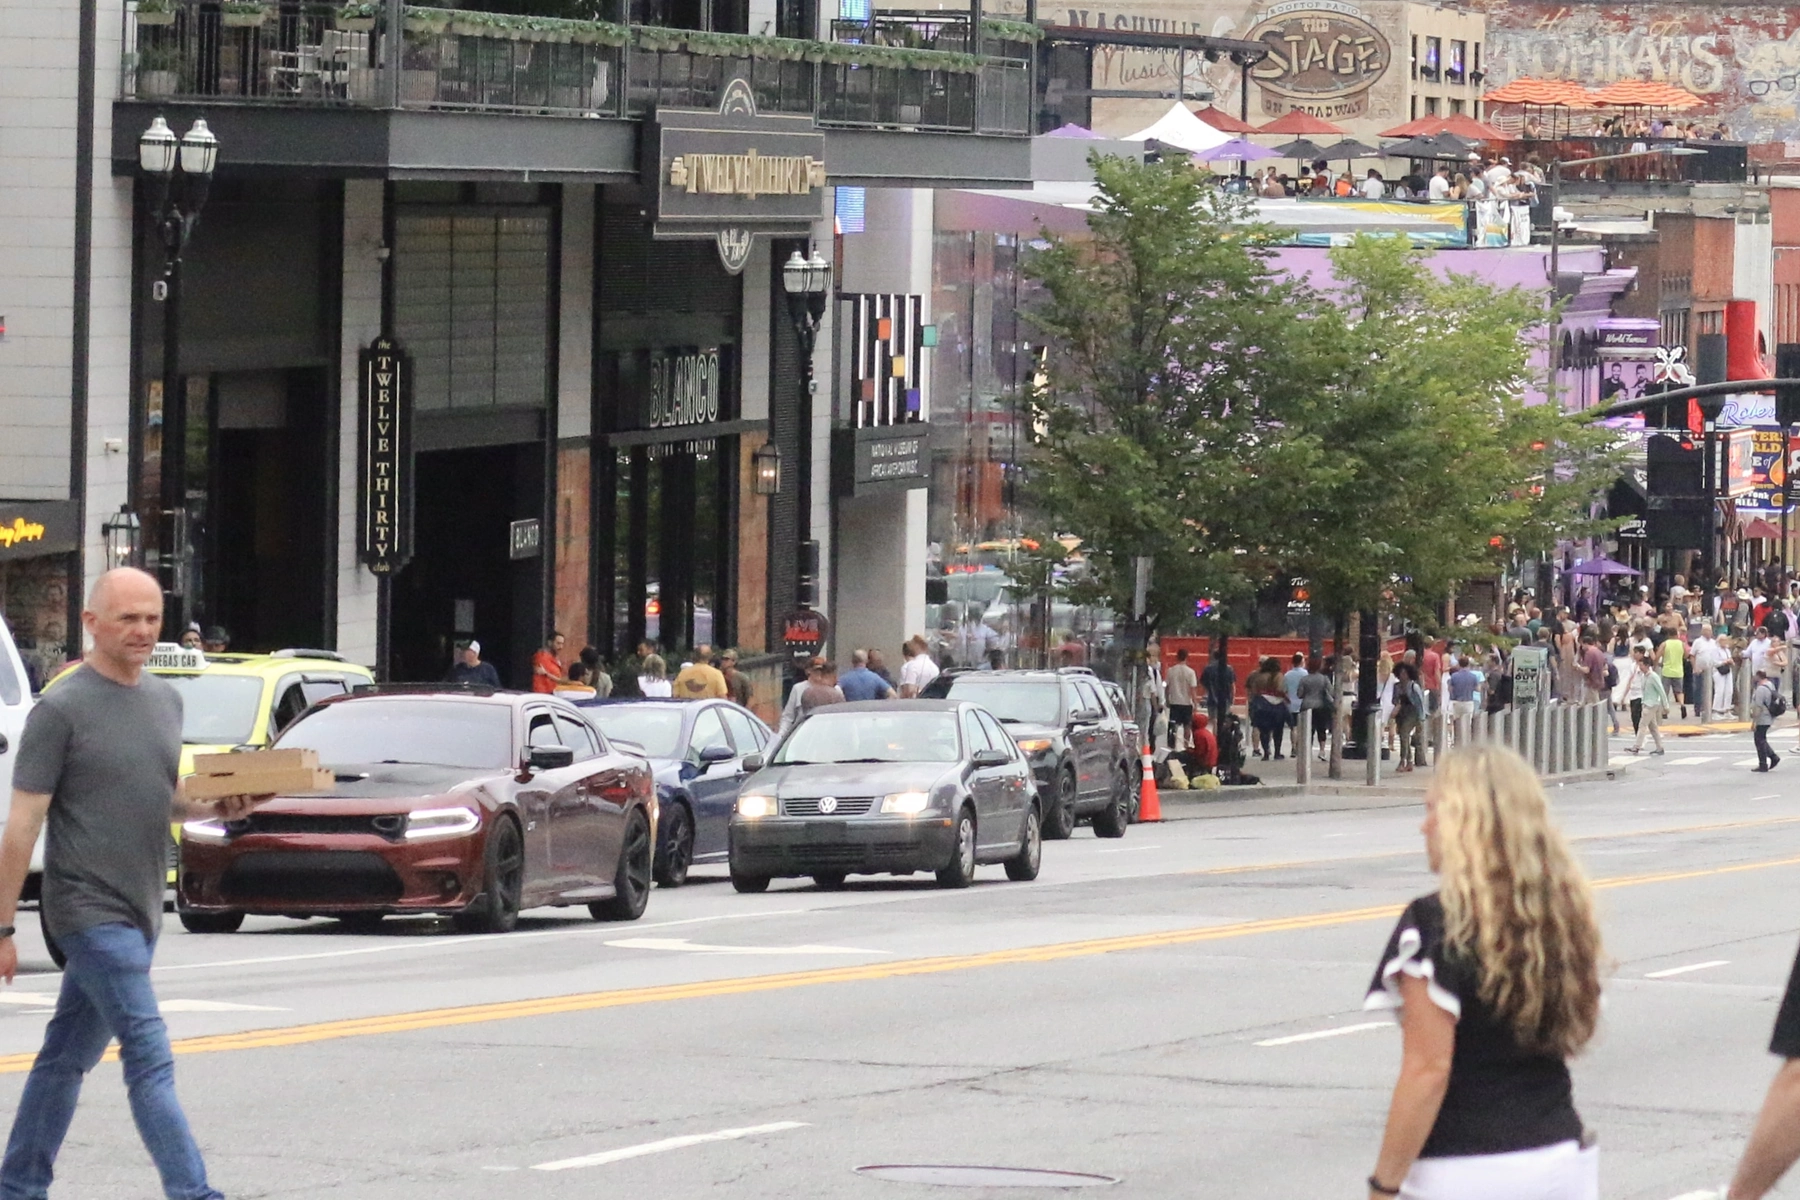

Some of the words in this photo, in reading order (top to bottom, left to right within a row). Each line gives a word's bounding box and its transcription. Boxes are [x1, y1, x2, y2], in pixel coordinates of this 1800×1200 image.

[1269, 2, 1313, 14] ROOFTOP
[1318, 2, 1360, 15] PATIO
[1251, 25, 1382, 78] STAGE
[686, 154, 752, 194] TWELVE
[755, 156, 813, 195] THIRTY
[377, 339, 391, 349] the
[1606, 333, 1624, 344] World
[1624, 334, 1648, 344] Famous
[376, 356, 392, 452] TWELVE
[650, 353, 718, 428] BLANCO
[375, 462, 390, 557] THIRTY
[515, 523, 539, 548] BLANCO
[182, 654, 197, 668] CAB
